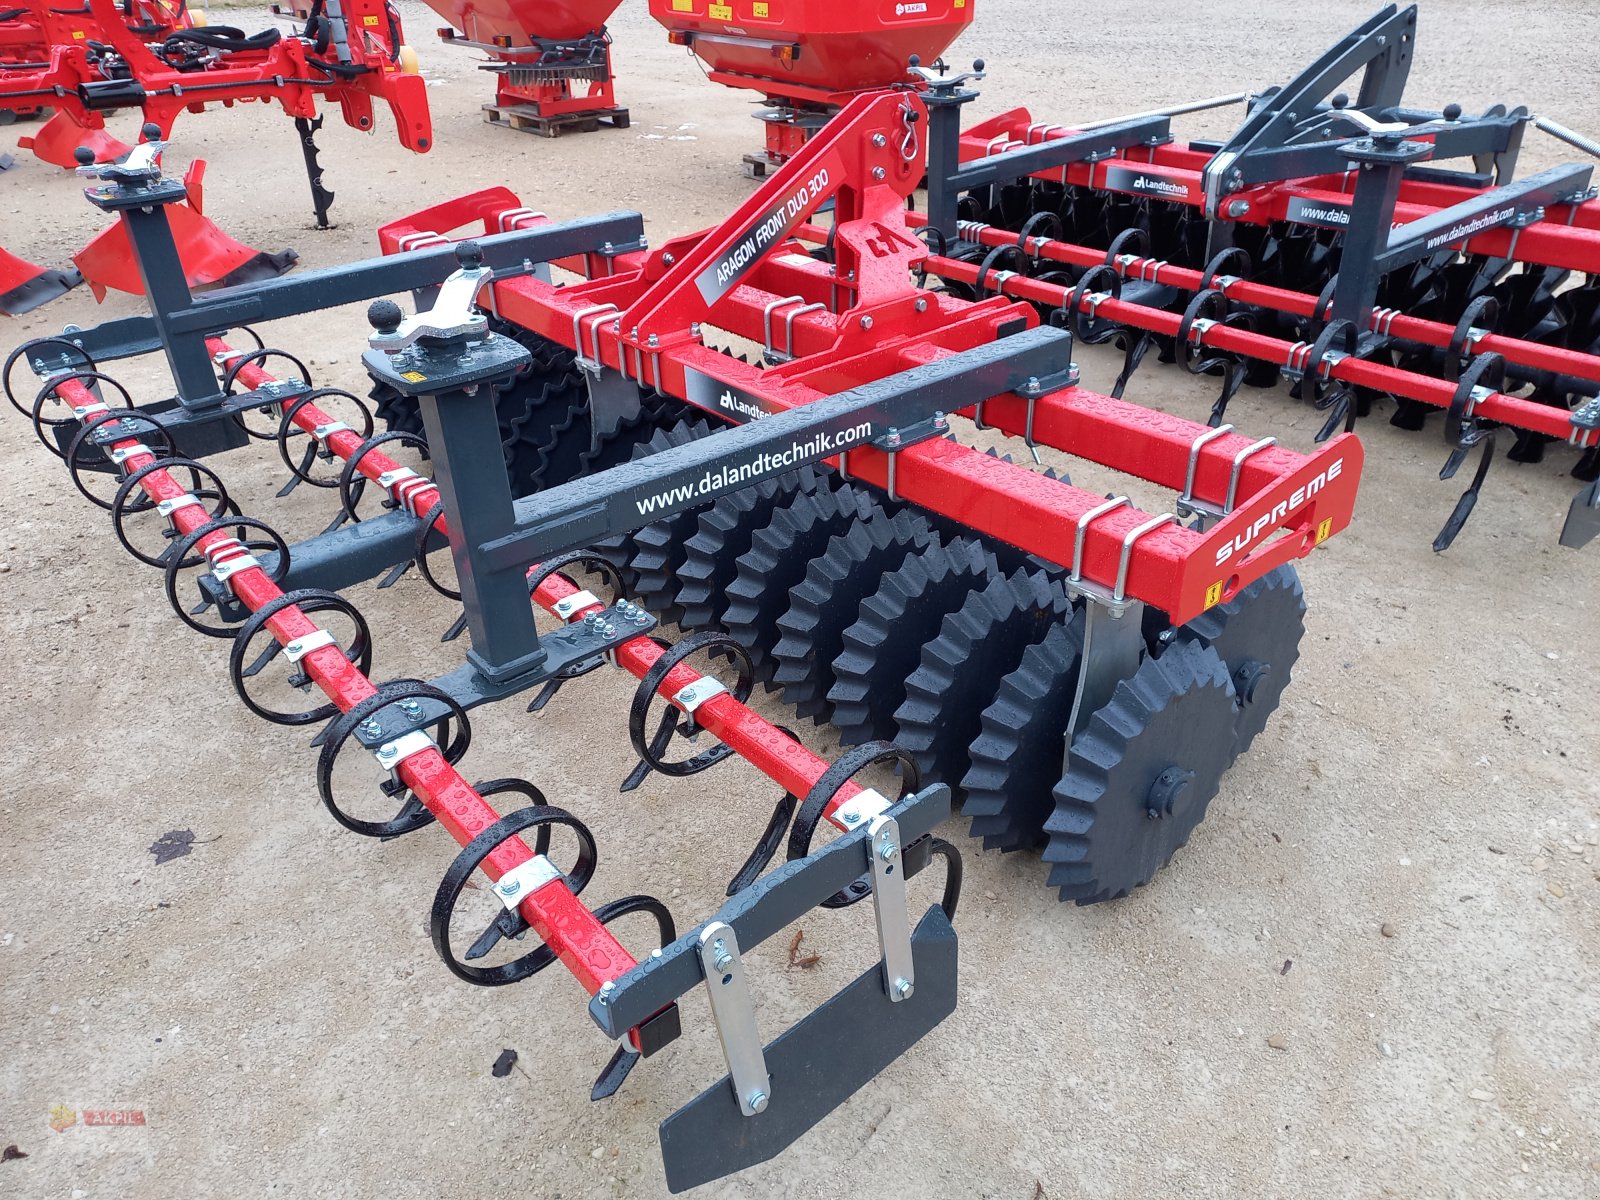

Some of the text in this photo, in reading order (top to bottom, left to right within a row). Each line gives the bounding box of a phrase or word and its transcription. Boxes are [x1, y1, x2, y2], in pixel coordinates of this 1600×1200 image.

[906, 3, 925, 12] AKPIL
[1145, 179, 1189, 195] Landtechnik
[716, 168, 829, 286] ARAGON FRONT DUO 300
[1301, 207, 1351, 225] www.dala
[1427, 207, 1515, 249] www.dalandtechnik.com
[636, 421, 872, 515] www.dalandtechnik.com
[1215, 457, 1344, 567] SUPREME
